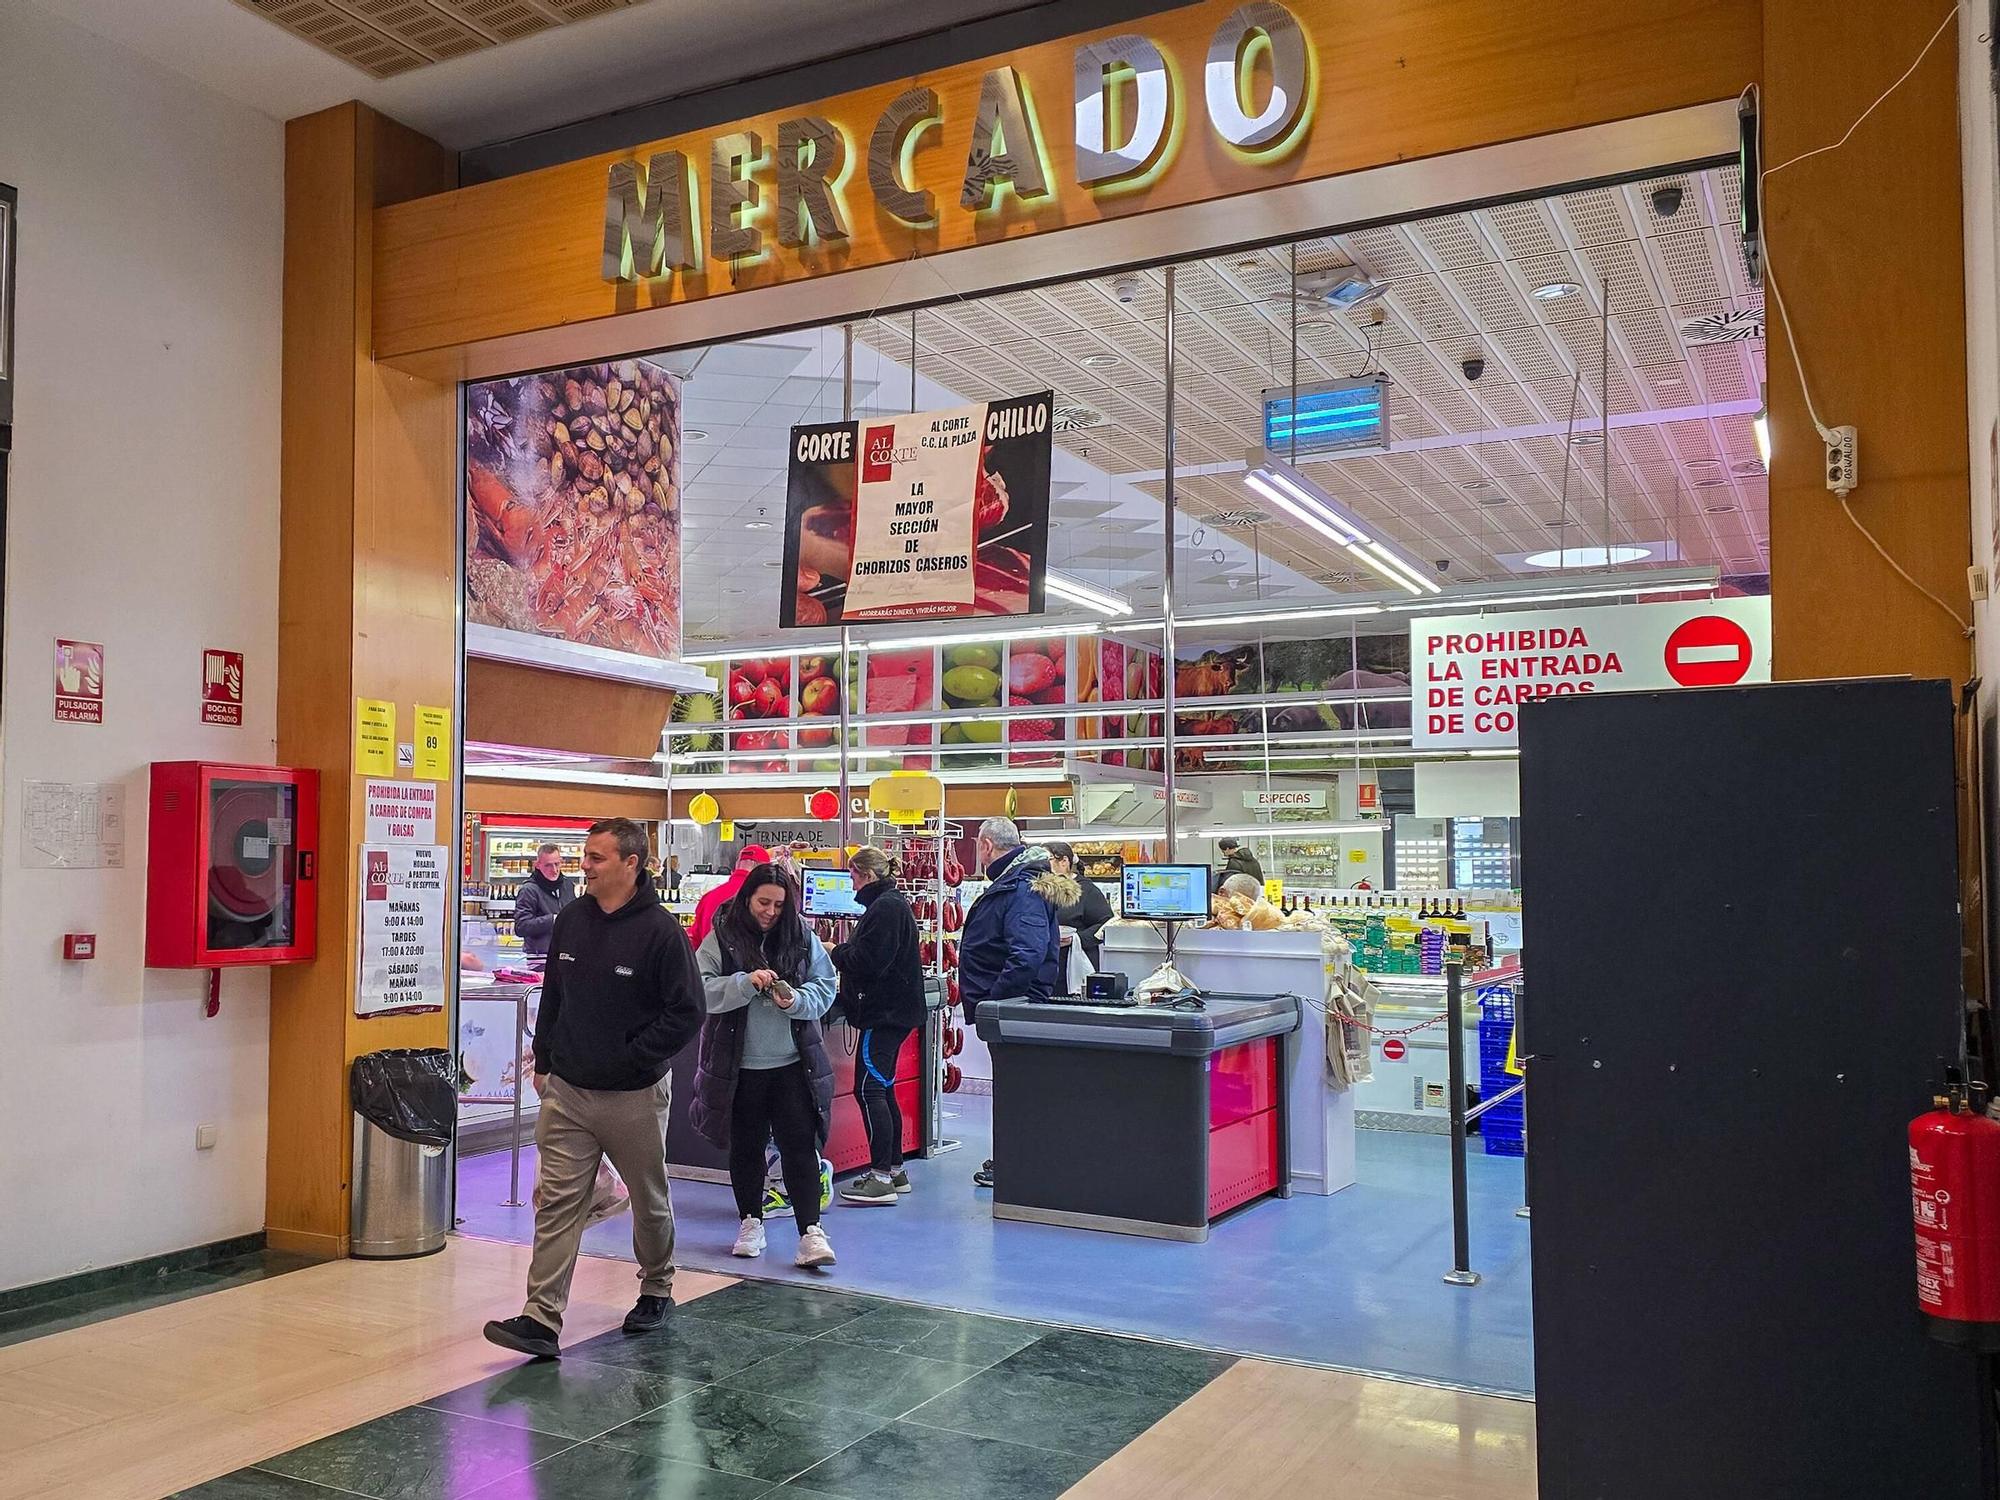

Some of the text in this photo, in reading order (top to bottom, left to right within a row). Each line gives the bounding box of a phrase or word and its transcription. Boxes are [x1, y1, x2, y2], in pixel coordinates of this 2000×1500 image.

[601, 0, 1312, 284] MERCADO
[931, 416, 970, 432] AL CORTE
[986, 403, 1047, 441] CHILLO
[871, 436, 891, 450] AL
[921, 430, 977, 448] C.C. LA PLAZA
[797, 431, 851, 462] CORTE
[870, 447, 918, 464] CORTE
[1844, 436, 1852, 479] OSWALDO
[911, 482, 924, 496] LA
[895, 500, 934, 516] MAYOR
[889, 518, 939, 535] SECCIÓN
[905, 539, 919, 553] DE
[855, 555, 968, 576] CHORIZOS CASEROS
[938, 605, 957, 613] MEJOR
[1427, 627, 1589, 655] PROHIBIDA
[1428, 652, 1624, 682] LA ENTRADA
[1427, 687, 1464, 708] DE
[58, 700, 98, 712] PULSADOR
[207, 704, 238, 715] BOCA DE
[57, 710, 100, 721] DE ALARMA
[206, 713, 238, 724] INCENDIO
[1428, 711, 1516, 734] DE CO
[426, 736, 438, 749] 89
[368, 785, 434, 802] PROHIBIDA LA ENTRADA
[370, 804, 432, 820] A CARROS DE COMPRA
[387, 824, 414, 837] Y BOLSAS
[808, 830, 824, 842] DE
[416, 850, 432, 858] NUEVO
[373, 861, 386, 872] AL
[413, 860, 436, 868] HORARIO
[372, 872, 404, 886] CORTE
[413, 870, 430, 878] PARTIR
[431, 870, 440, 879] DEL
[388, 901, 420, 912] MAÑANAS
[384, 916, 424, 926] 9:00 A 14:00
[392, 932, 416, 942] TARDES
[382, 946, 424, 956] 17:00 A 20:00
[388, 962, 418, 974] SÁBADOS
[390, 976, 416, 988] MAÑANA
[384, 991, 422, 1003] 9:00 A 14:00
